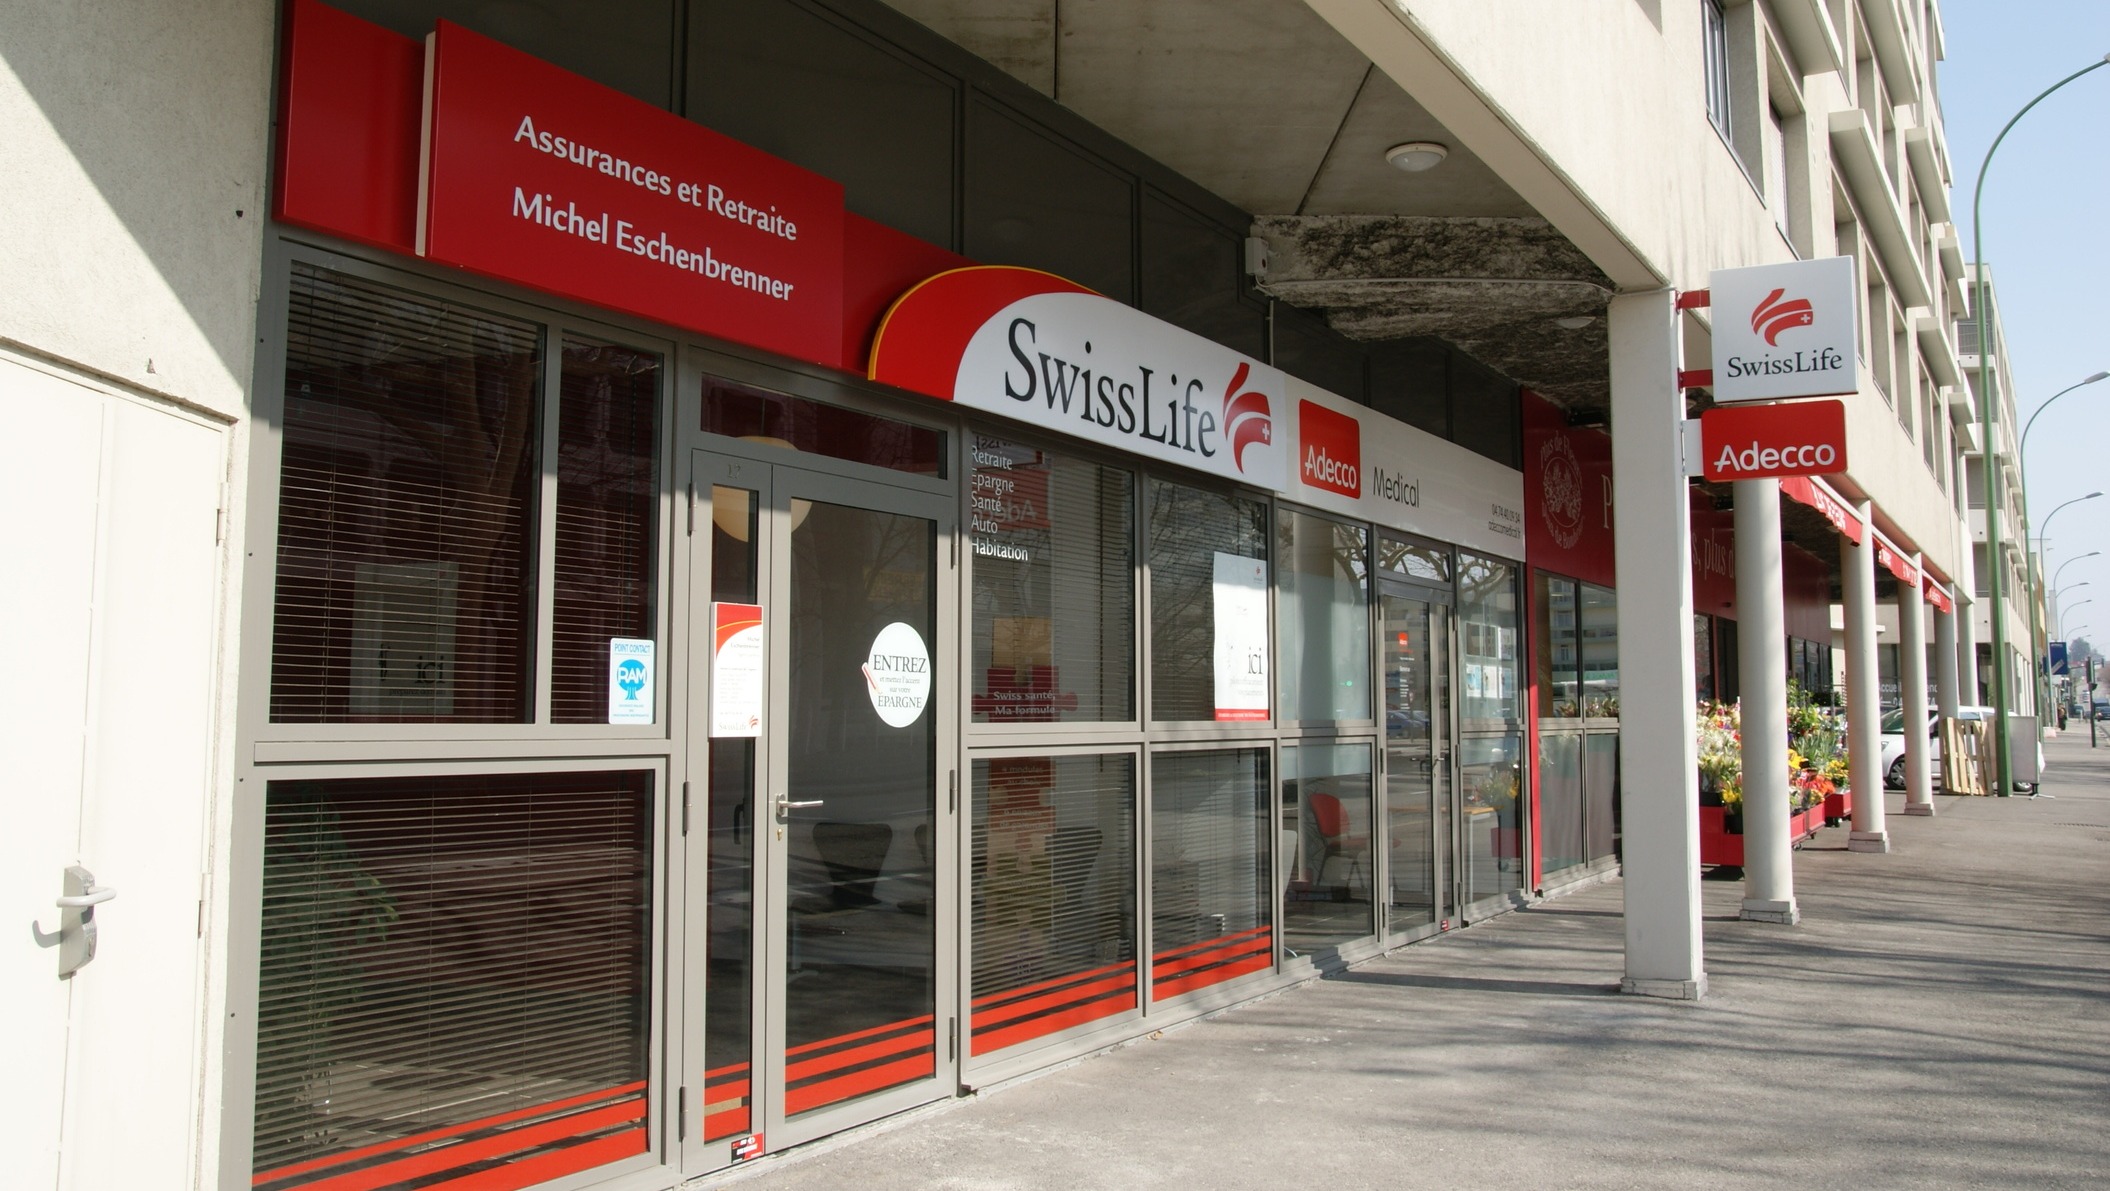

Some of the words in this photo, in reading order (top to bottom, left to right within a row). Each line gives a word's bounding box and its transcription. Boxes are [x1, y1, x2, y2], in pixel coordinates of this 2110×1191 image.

[513, 115, 671, 196] Assurances
[676, 180, 702, 208] et
[706, 184, 797, 242] Retraite
[512, 186, 609, 245] Michel
[616, 219, 794, 302] Eschenbrenner
[1727, 346, 1843, 379] SwissLife
[1004, 317, 1217, 458] SwissLife
[972, 445, 1012, 470] Retraite
[1304, 443, 1358, 490] Adecco
[1713, 441, 1836, 473] Adecco
[1372, 466, 1420, 508] Medical
[971, 491, 1001, 512] Santé
[971, 514, 998, 534] Auto
[971, 536, 1028, 561] Habitation
[1704, 527, 1726, 580] plus
[614, 643, 629, 653] POINT
[629, 644, 650, 654] CONTACT
[1248, 647, 1264, 675] ici
[415, 655, 446, 684] ici
[618, 666, 647, 685] RAM
[873, 654, 927, 673] ENTREZ
[993, 690, 1022, 700] Swiss
[995, 705, 1012, 715] Ma
[1015, 704, 1056, 715] formule
